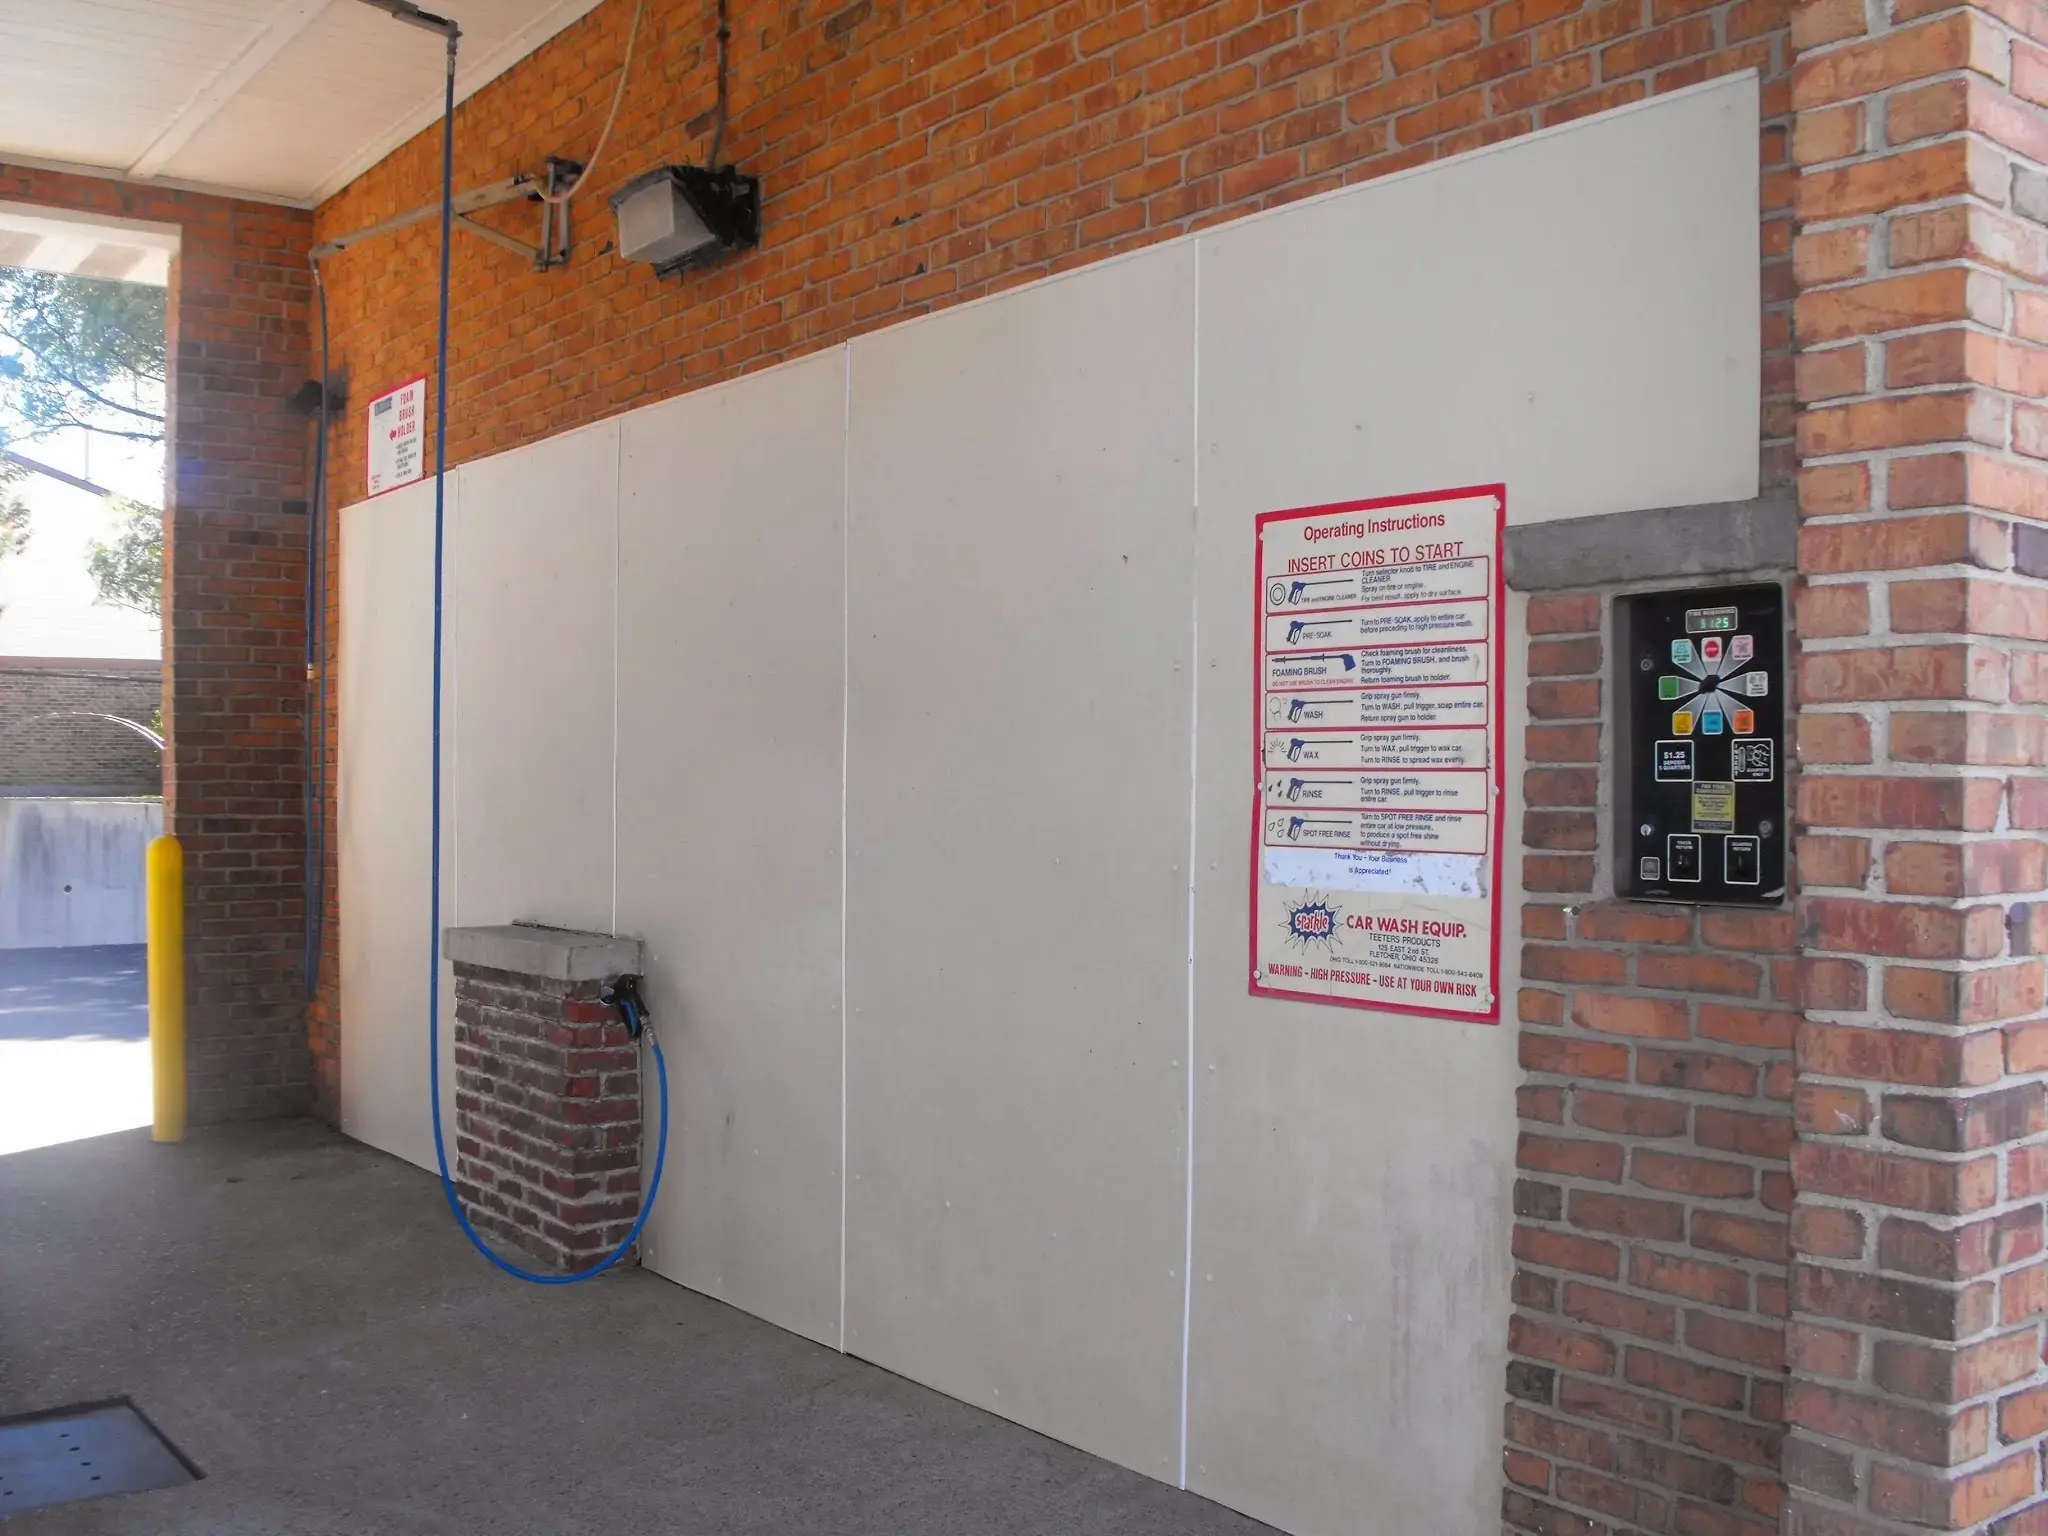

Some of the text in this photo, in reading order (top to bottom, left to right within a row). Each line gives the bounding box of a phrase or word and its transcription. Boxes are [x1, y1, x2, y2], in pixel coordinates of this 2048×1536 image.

[401, 390, 413, 405] FOAM
[399, 405, 415, 421] BRUSH
[397, 421, 416, 438] HOLDER
[1304, 514, 1445, 543] Operating Instructions
[1288, 541, 1463, 573] INSERT COINS TO START
[1362, 576, 1390, 584] CLEANER
[1303, 631, 1331, 639] PRE-SOAK
[1382, 658, 1411, 666] FOAMING
[1272, 667, 1327, 677] FOAMING BRUSH
[1399, 745, 1409, 753] pull
[1411, 745, 1429, 753] trigger
[1409, 756, 1429, 764] spread
[1302, 790, 1322, 798] RINSE
[1415, 789, 1434, 797] trigger
[1367, 831, 1390, 839] produce
[1354, 867, 1391, 875] Appreciated!
[1347, 915, 1466, 938] CAR WASH EQUIP.
[1369, 933, 1440, 947] TEETERS PRODUCTS
[1394, 964, 1424, 972] NATIONWIDE
[1268, 963, 1477, 997] WARNING HIGH PRESSURE USE AT YOUR OWN RISK
